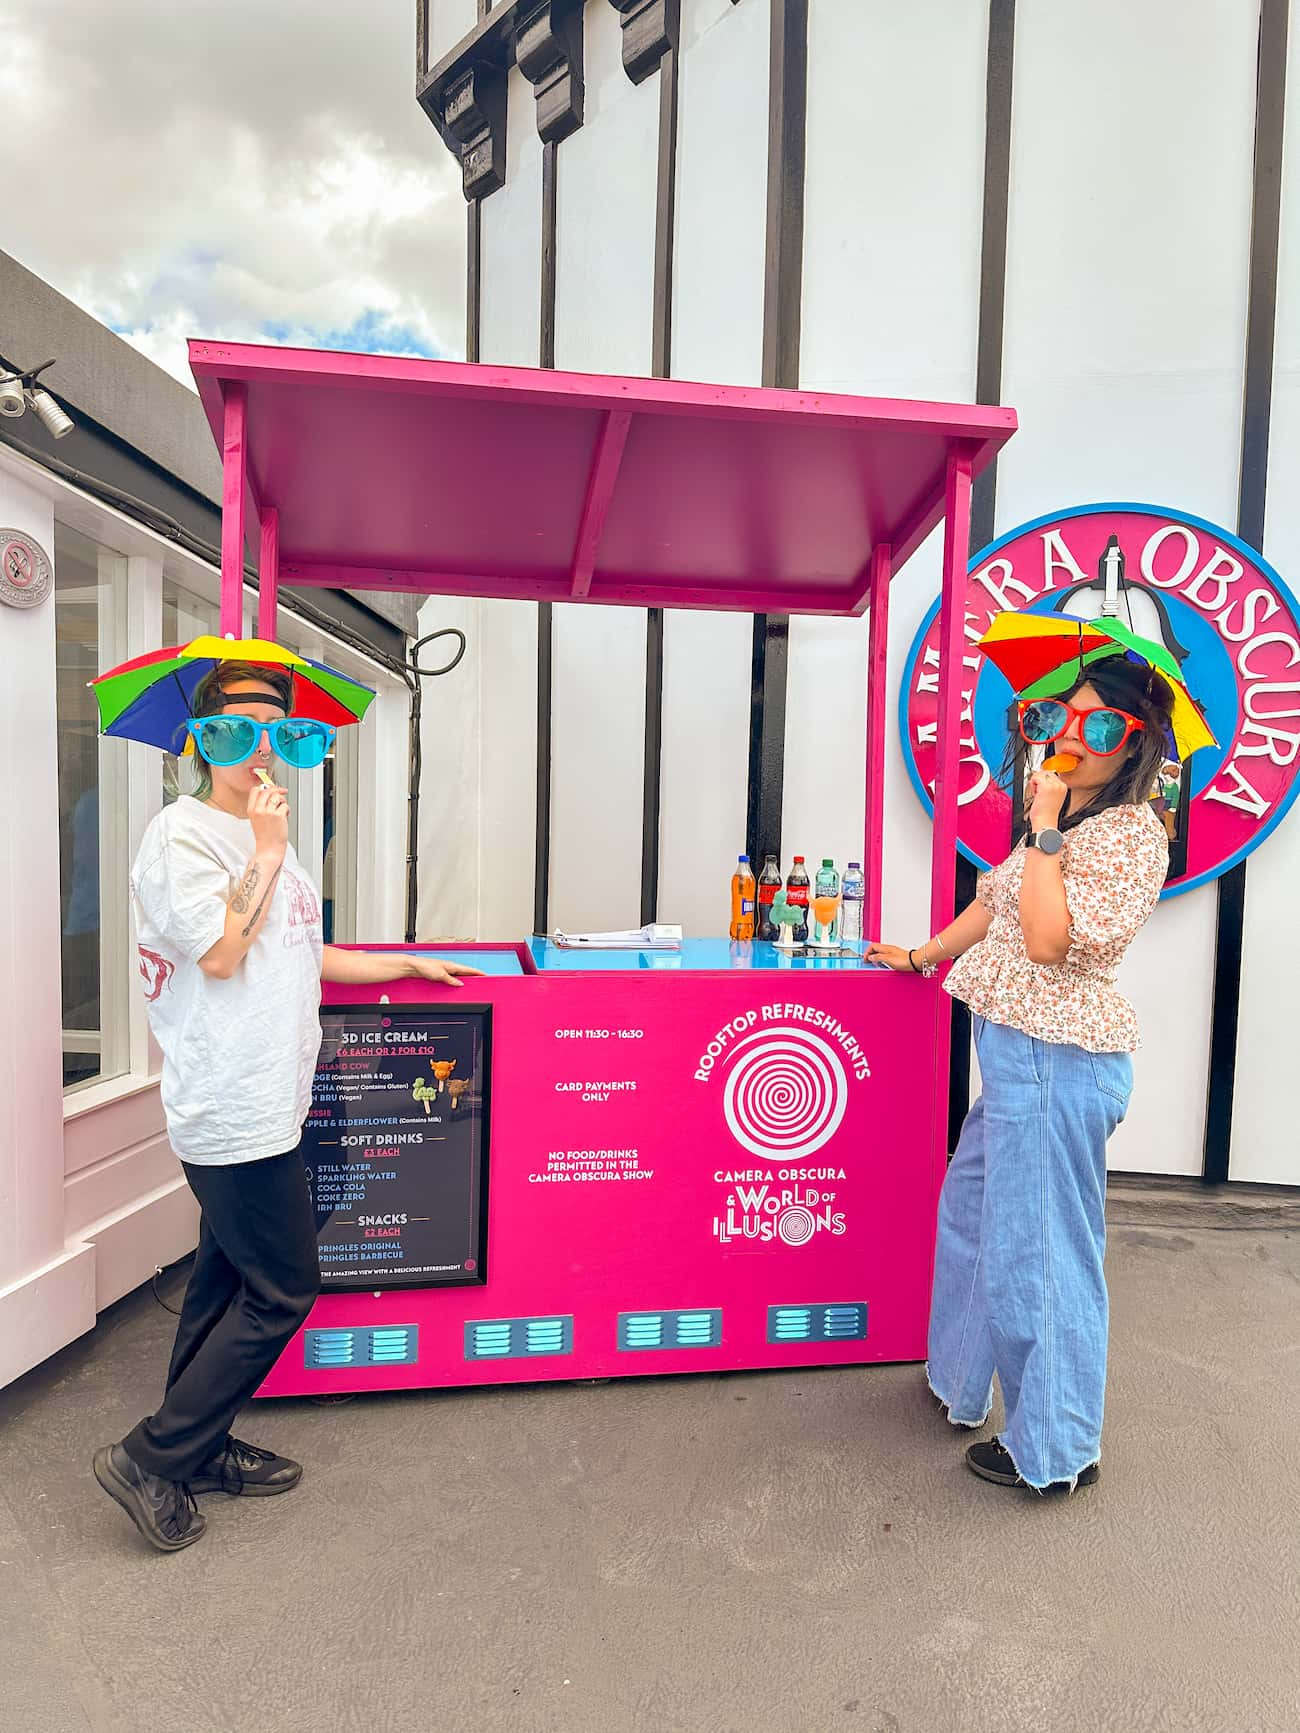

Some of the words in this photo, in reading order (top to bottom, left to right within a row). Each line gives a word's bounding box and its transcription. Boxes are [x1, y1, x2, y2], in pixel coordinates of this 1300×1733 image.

[1140, 524, 1300, 819] OBSCURA
[342, 1033, 358, 1044] 3D
[361, 1033, 382, 1044] ICE
[384, 1032, 428, 1042] CREAM
[555, 1030, 582, 1039] OPEN
[584, 1030, 609, 1038] 11:30
[618, 1030, 644, 1038] 16:30
[694, 1010, 758, 1082] ROOFTOP
[761, 1003, 871, 1081] REFRESHMENTS
[350, 1048, 373, 1056] EACH
[376, 1047, 388, 1056] OR
[391, 1047, 396, 1056] 2
[398, 1046, 416, 1056] FOR
[350, 1062, 369, 1070] COW
[312, 1084, 335, 1092] OCHA
[555, 1082, 582, 1092] CARD
[585, 1082, 636, 1091] PAYMENTS
[320, 1094, 338, 1102] BRU
[582, 1092, 610, 1102] ONLY
[308, 1110, 332, 1118] ESSIE
[338, 1116, 398, 1126] ELDERFLOWER
[340, 1135, 373, 1146] SOFT
[376, 1133, 424, 1145] DRINKS
[378, 1148, 400, 1156] EACH
[548, 1152, 564, 1160] NO
[567, 1149, 638, 1160] FOOD/DRINKS
[318, 1164, 340, 1172] STILL
[342, 1163, 371, 1172] WATER
[548, 1162, 604, 1172] PERMITTED
[606, 1160, 616, 1170] IN
[619, 1160, 638, 1169] THE
[318, 1174, 366, 1182] SPARKLING
[367, 1172, 396, 1180] WATER
[528, 1173, 571, 1182] CAMERA
[573, 1171, 620, 1181] OBSCURA
[623, 1170, 654, 1180] SHOW
[713, 1170, 774, 1182] CAMERA
[778, 1168, 846, 1180] OBSCURA
[317, 1184, 342, 1192] COCA
[343, 1183, 366, 1191] COLA
[317, 1194, 340, 1202] COKE
[342, 1192, 366, 1200] ZERO
[726, 1194, 736, 1206] &
[735, 1184, 819, 1214] WORLD
[822, 1193, 836, 1202] OF
[317, 1204, 333, 1212] IRN
[335, 1203, 352, 1211] BRU
[358, 1214, 408, 1226] SNACKS
[713, 1204, 846, 1246] ILLUSIONS
[378, 1227, 400, 1237] EACH
[318, 1244, 358, 1252] PRINGLES
[360, 1242, 402, 1251] ORIGINAL
[318, 1254, 358, 1262] PRINGLES
[360, 1252, 404, 1260] BARBECUE
[394, 1266, 422, 1274] DELICIOUS
[422, 1264, 460, 1272] REFRESHMENT
